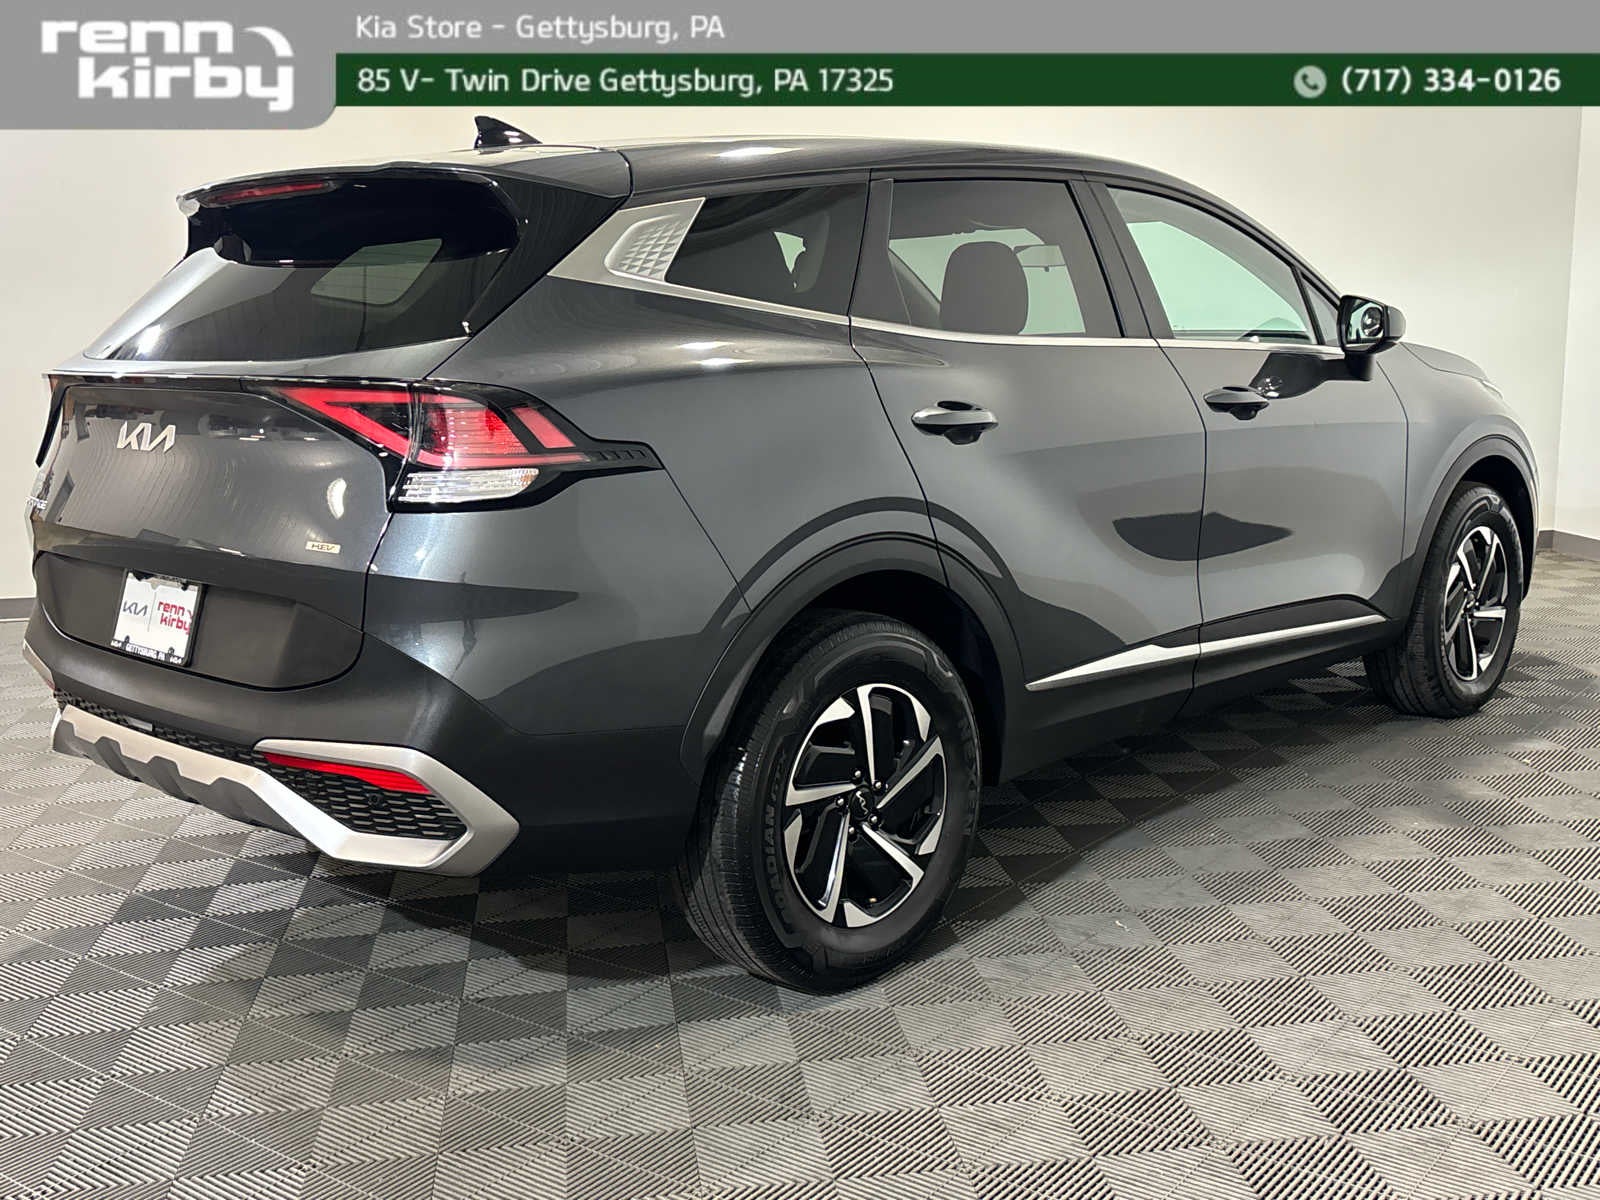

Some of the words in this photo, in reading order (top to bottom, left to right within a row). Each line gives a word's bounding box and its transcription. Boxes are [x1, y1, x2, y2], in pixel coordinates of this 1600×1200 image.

[116, 420, 177, 454] KIA
[311, 542, 336, 552] HEV
[122, 601, 148, 617] KIA
[157, 601, 185, 616] renn
[159, 613, 191, 636] kirby
